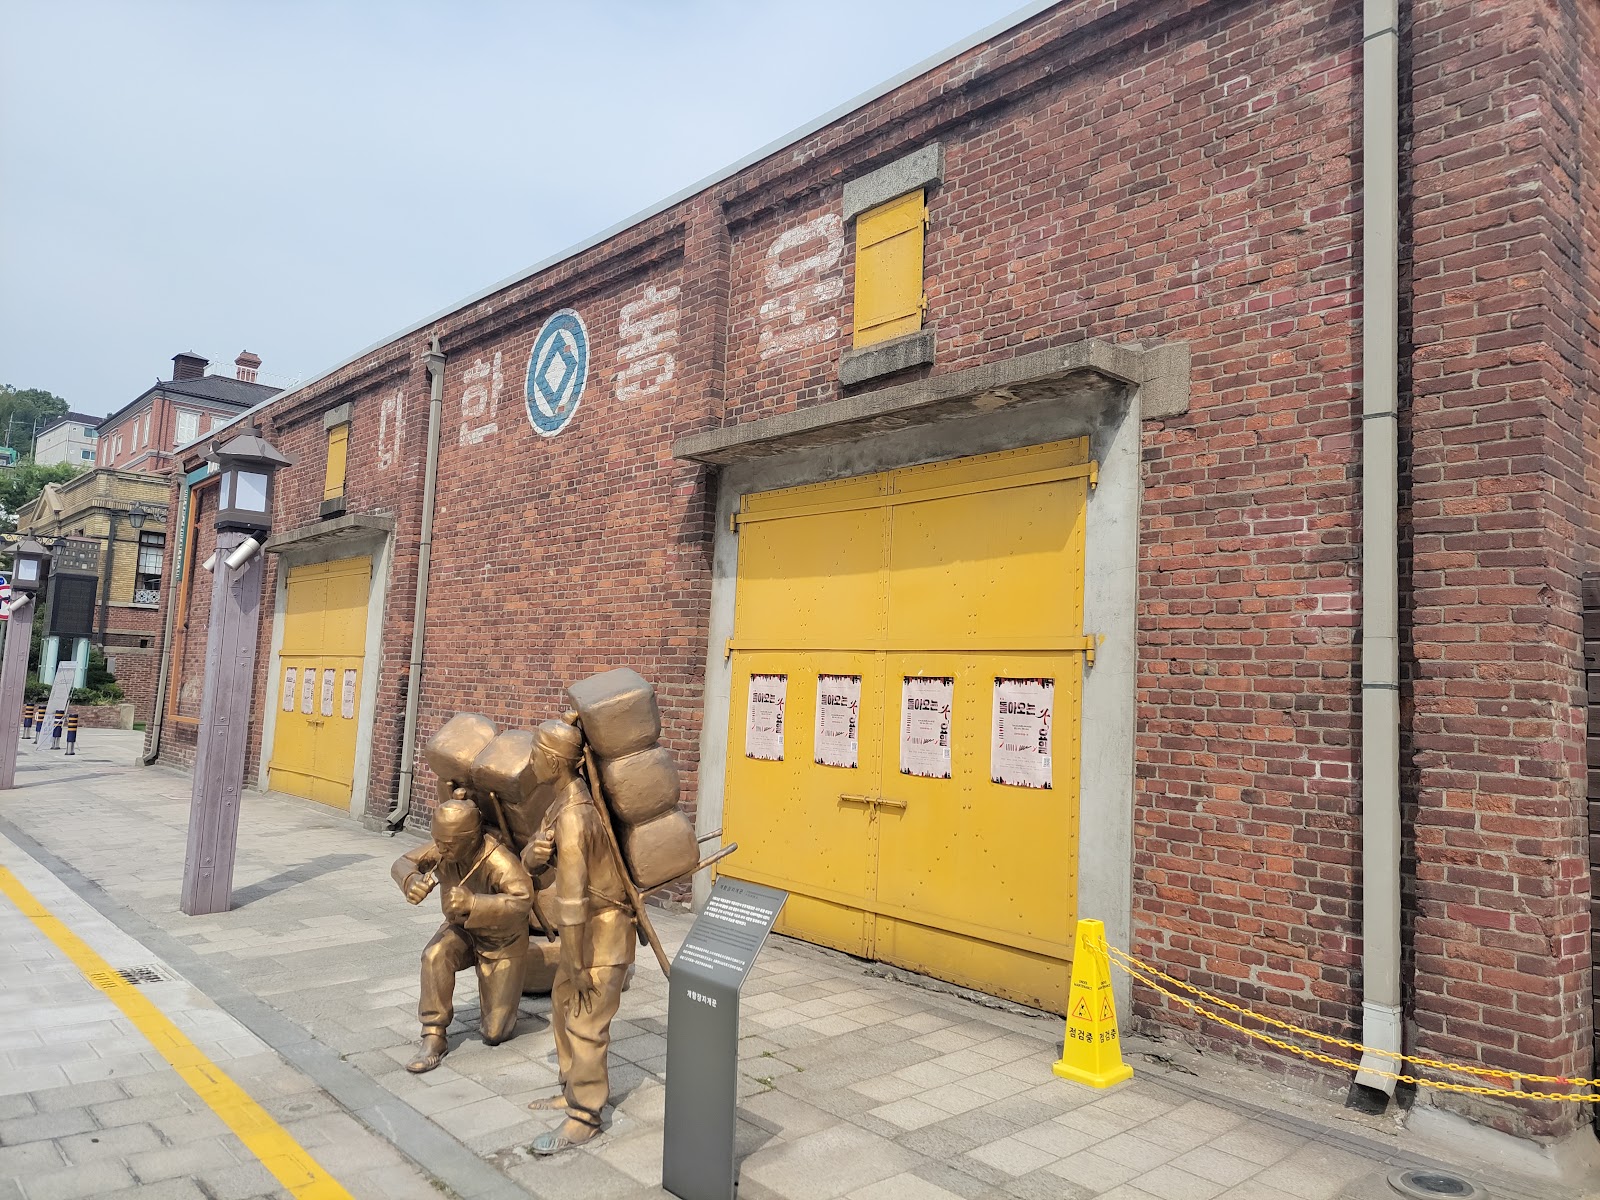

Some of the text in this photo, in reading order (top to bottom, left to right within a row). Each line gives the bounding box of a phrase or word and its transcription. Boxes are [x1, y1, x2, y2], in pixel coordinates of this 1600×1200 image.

[459, 349, 503, 447] 한
[616, 284, 682, 402] 통
[758, 212, 845, 361] 운
[1069, 1027, 1094, 1044] 점검중
[1099, 1028, 1117, 1044] 점검중
